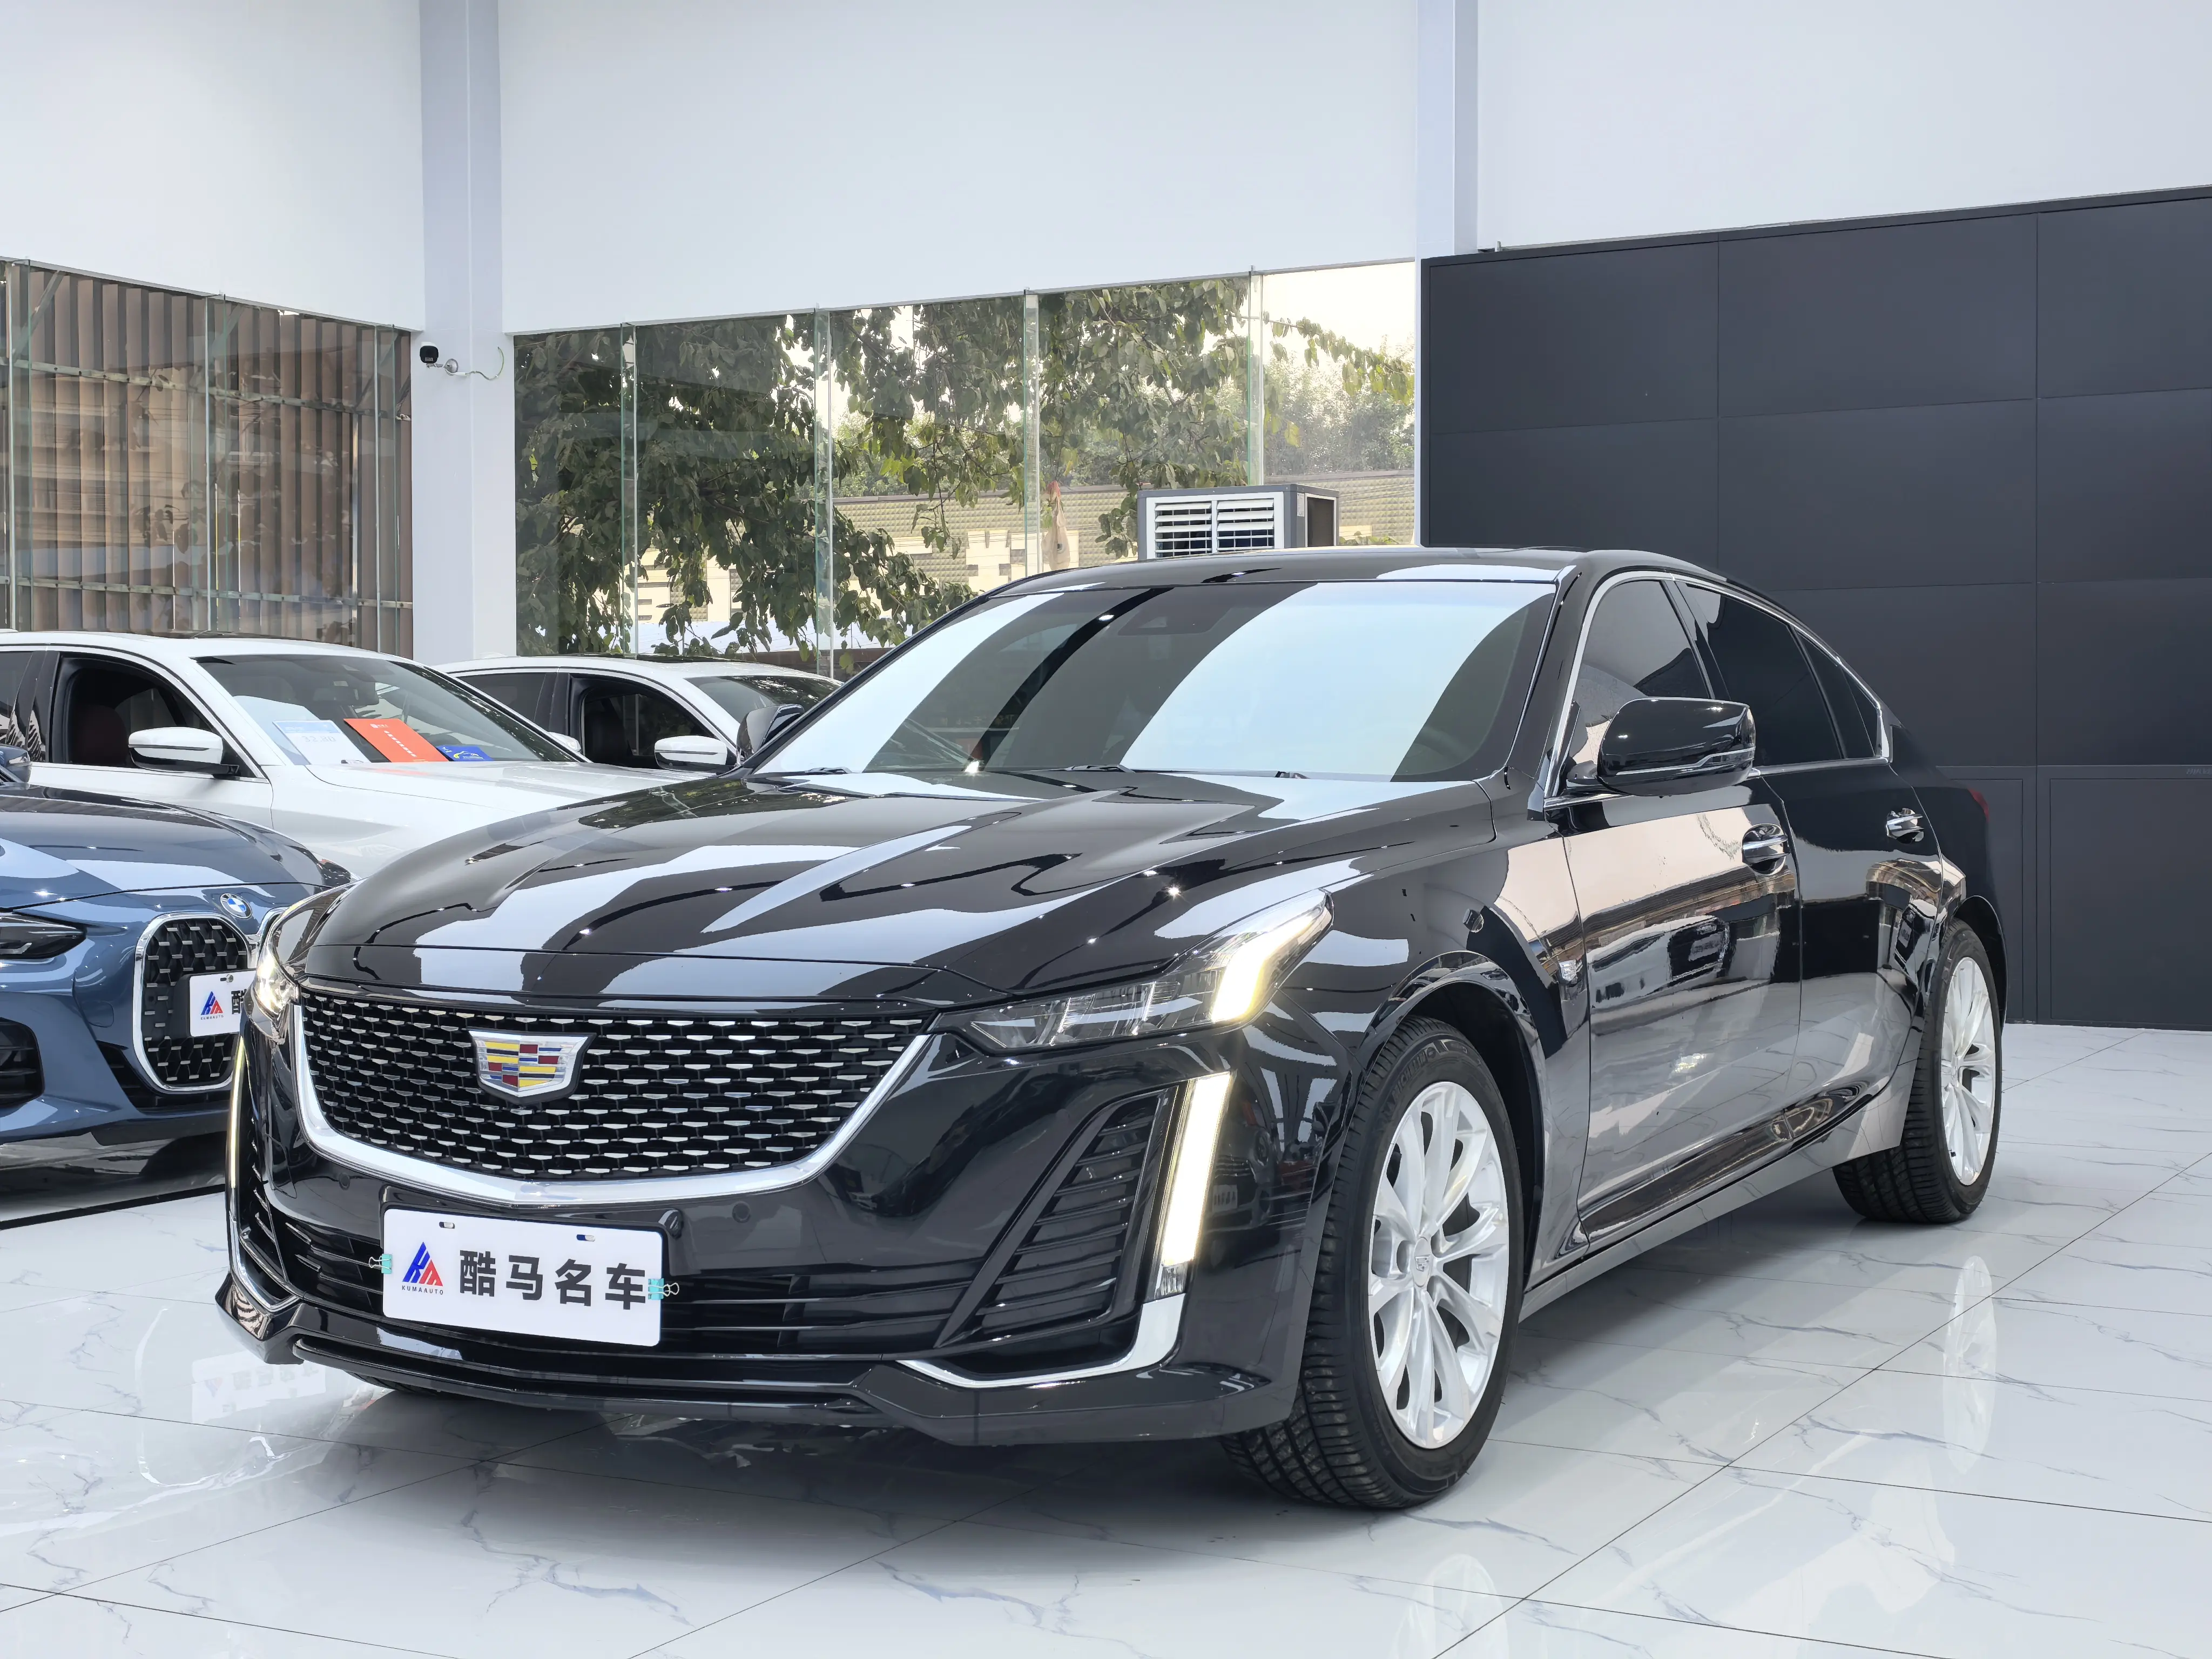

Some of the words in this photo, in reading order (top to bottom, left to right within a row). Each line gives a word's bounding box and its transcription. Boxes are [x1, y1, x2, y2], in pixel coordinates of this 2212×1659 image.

[401, 1285, 444, 1295] KUMAAUTO
[460, 1250, 646, 1310] 酷马名车
